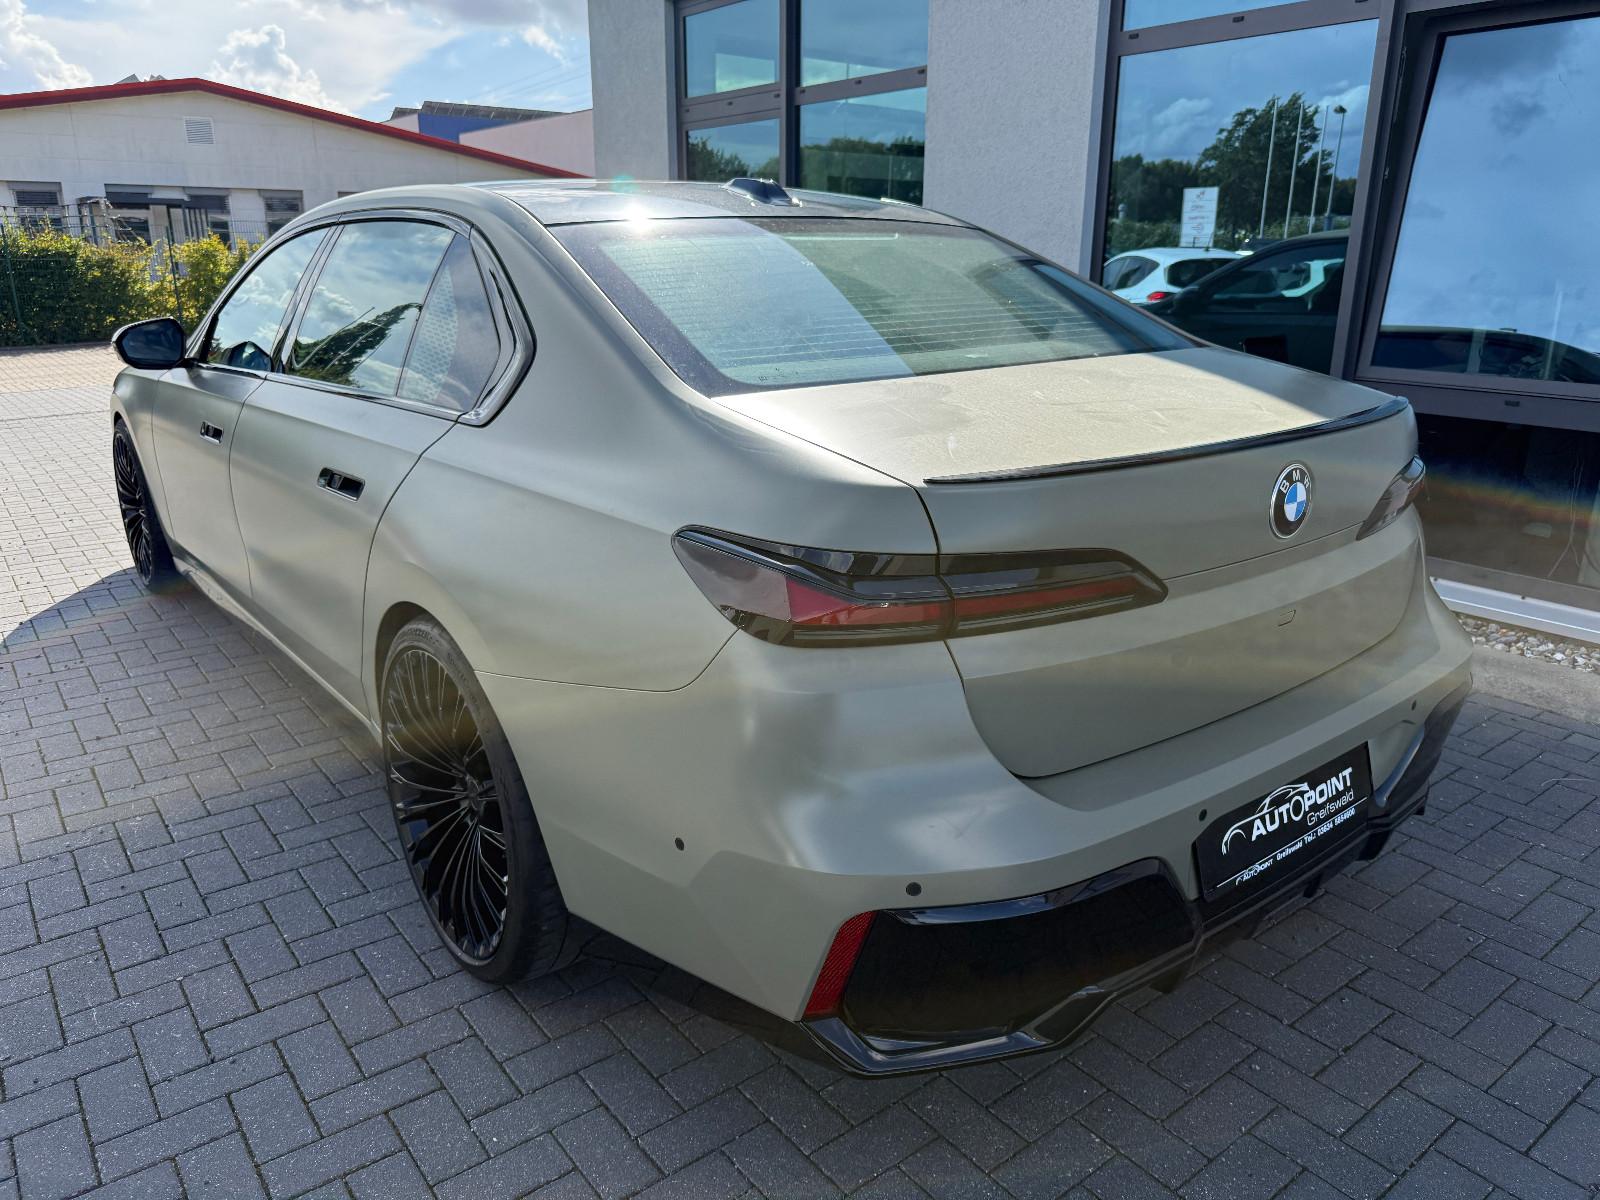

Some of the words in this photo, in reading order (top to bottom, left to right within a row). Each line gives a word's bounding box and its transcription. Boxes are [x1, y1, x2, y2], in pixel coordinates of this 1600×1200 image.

[1279, 469, 1310, 494] BMW
[1251, 766, 1352, 842] AUTOPOINT
[1307, 788, 1354, 826] Greifswald
